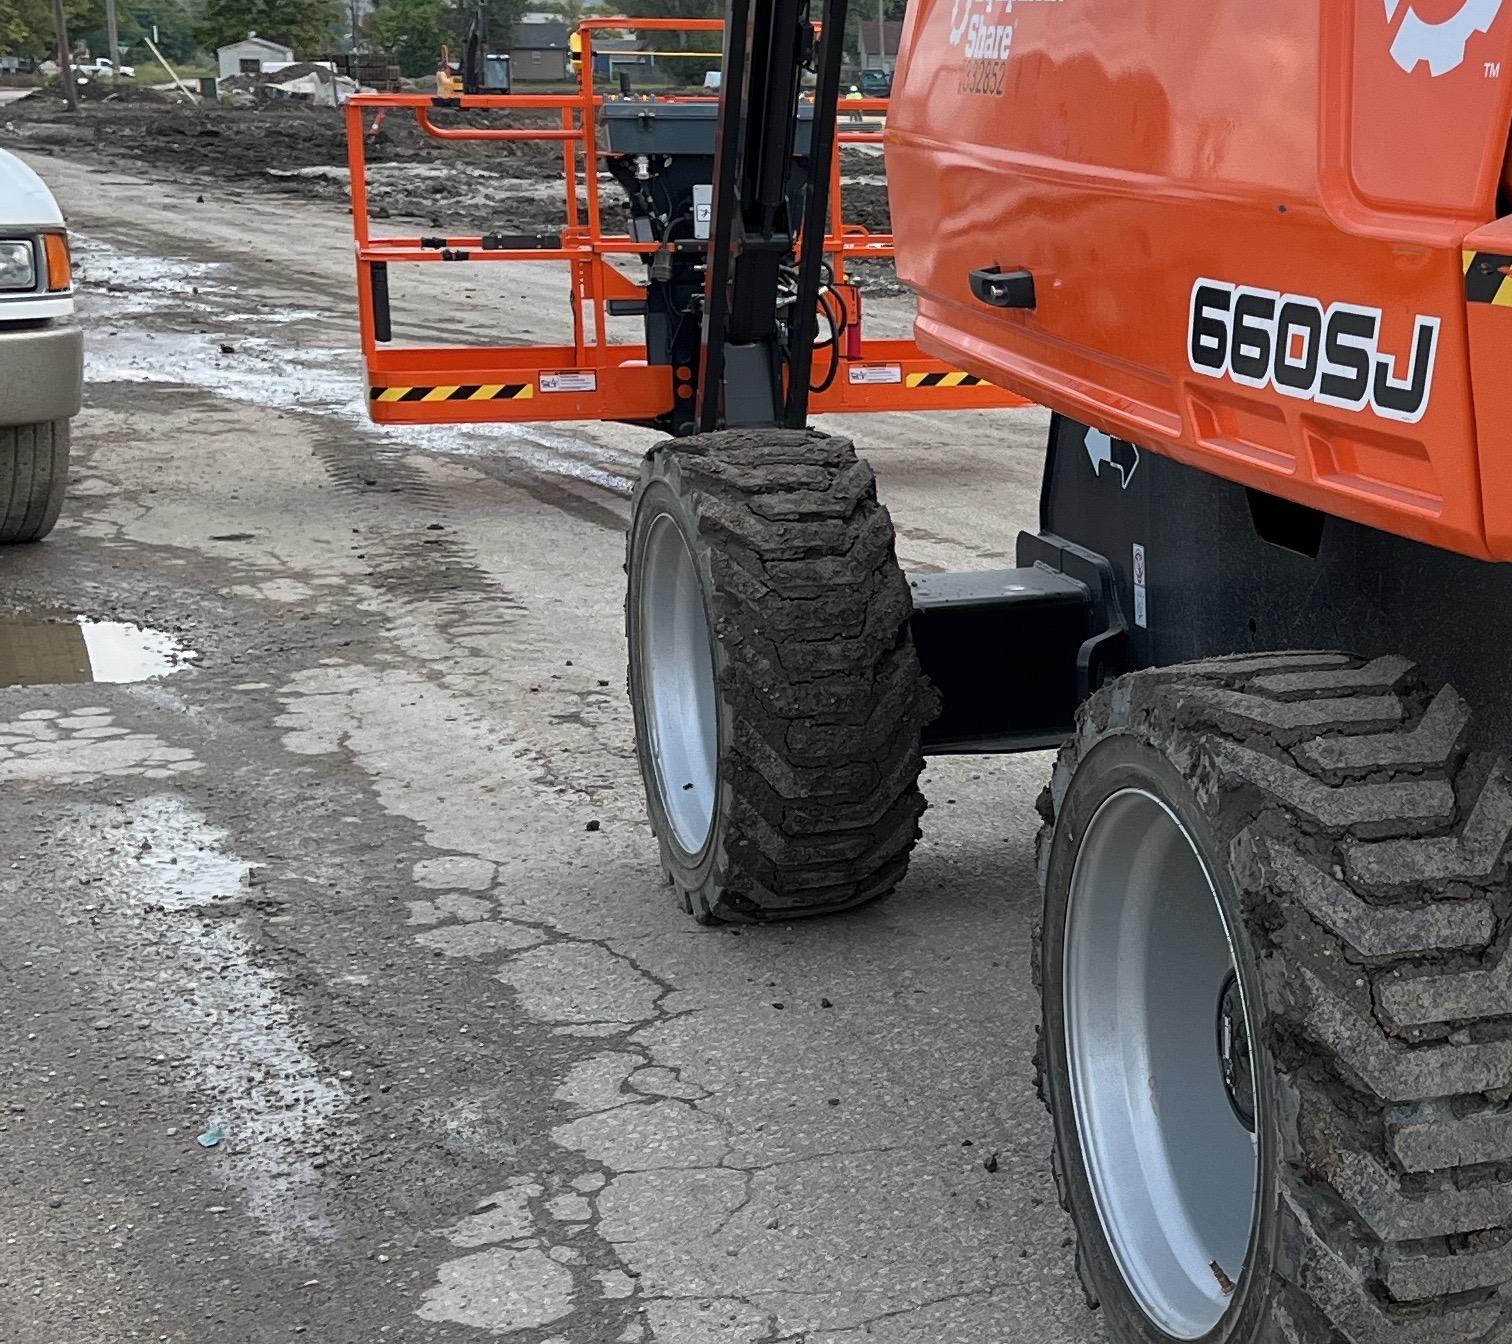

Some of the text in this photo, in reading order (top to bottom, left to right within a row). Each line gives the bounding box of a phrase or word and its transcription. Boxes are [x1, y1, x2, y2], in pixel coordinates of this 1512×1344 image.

[965, 14, 1013, 59] Share
[1483, 62, 1500, 78] TM
[1190, 283, 1436, 415] 660SJ
